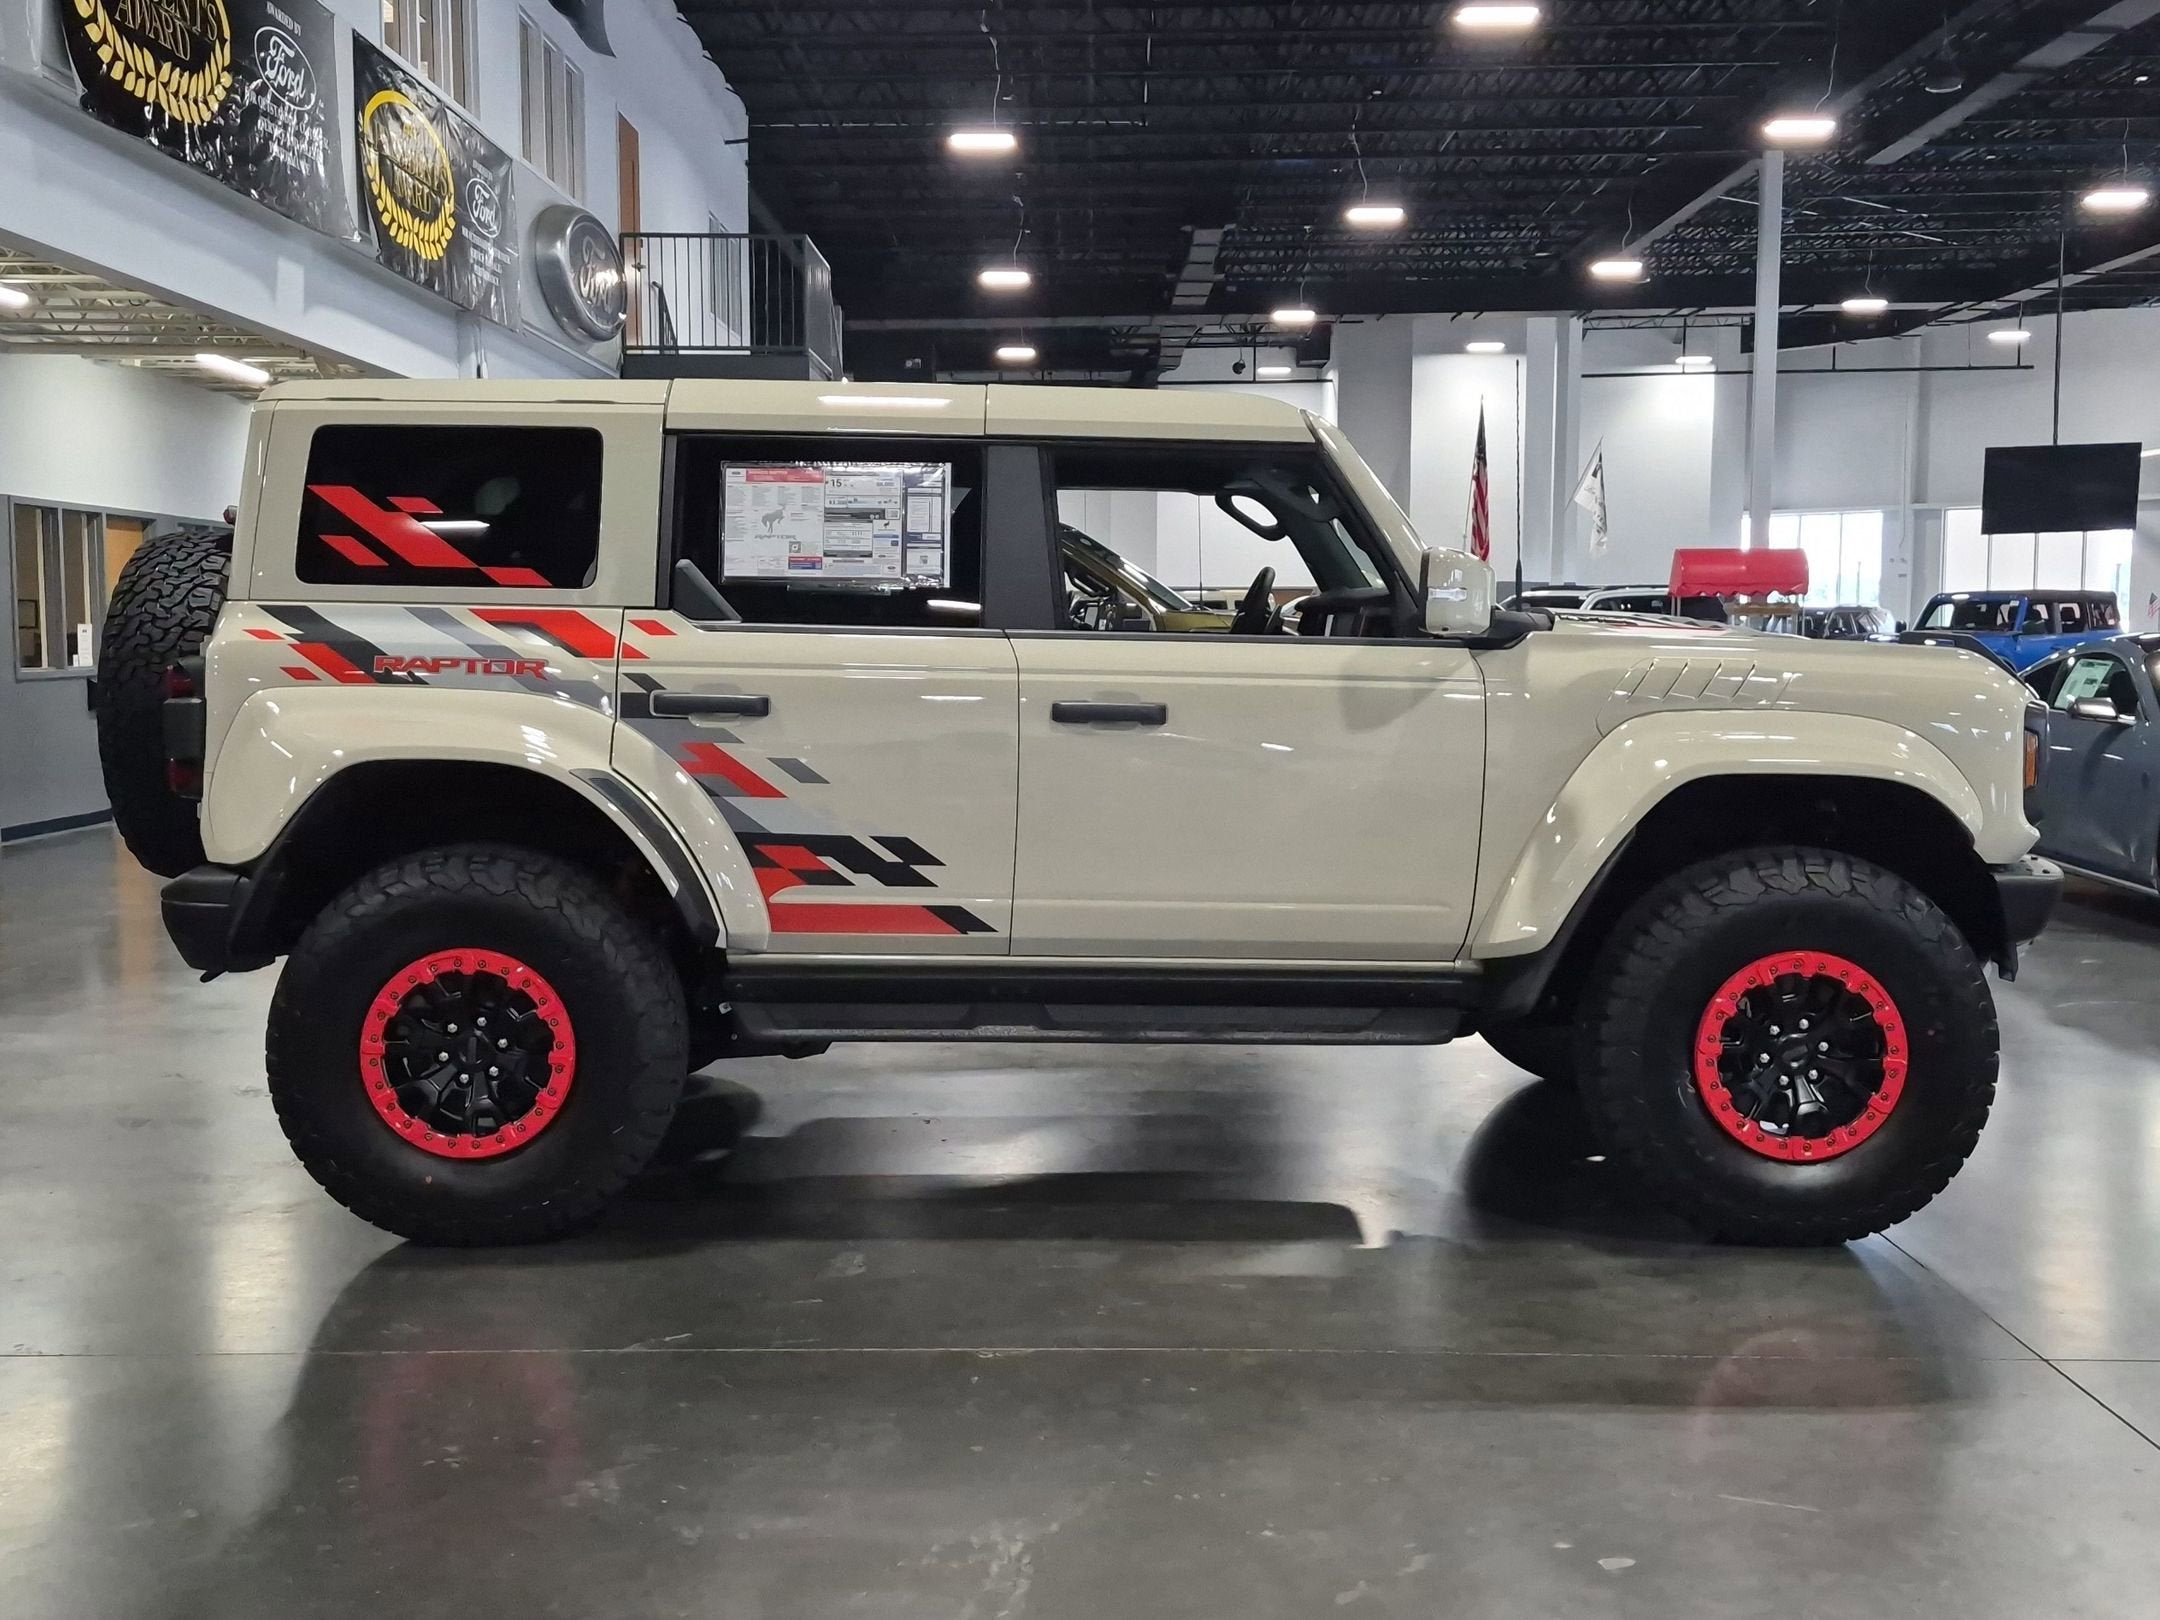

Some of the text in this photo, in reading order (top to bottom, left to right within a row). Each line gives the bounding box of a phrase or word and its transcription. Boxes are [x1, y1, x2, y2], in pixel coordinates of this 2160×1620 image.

[265, 35, 306, 99] Ford
[472, 184, 497, 228] Ford
[831, 478, 842, 488] 15
[373, 655, 550, 682] RAPTOR
